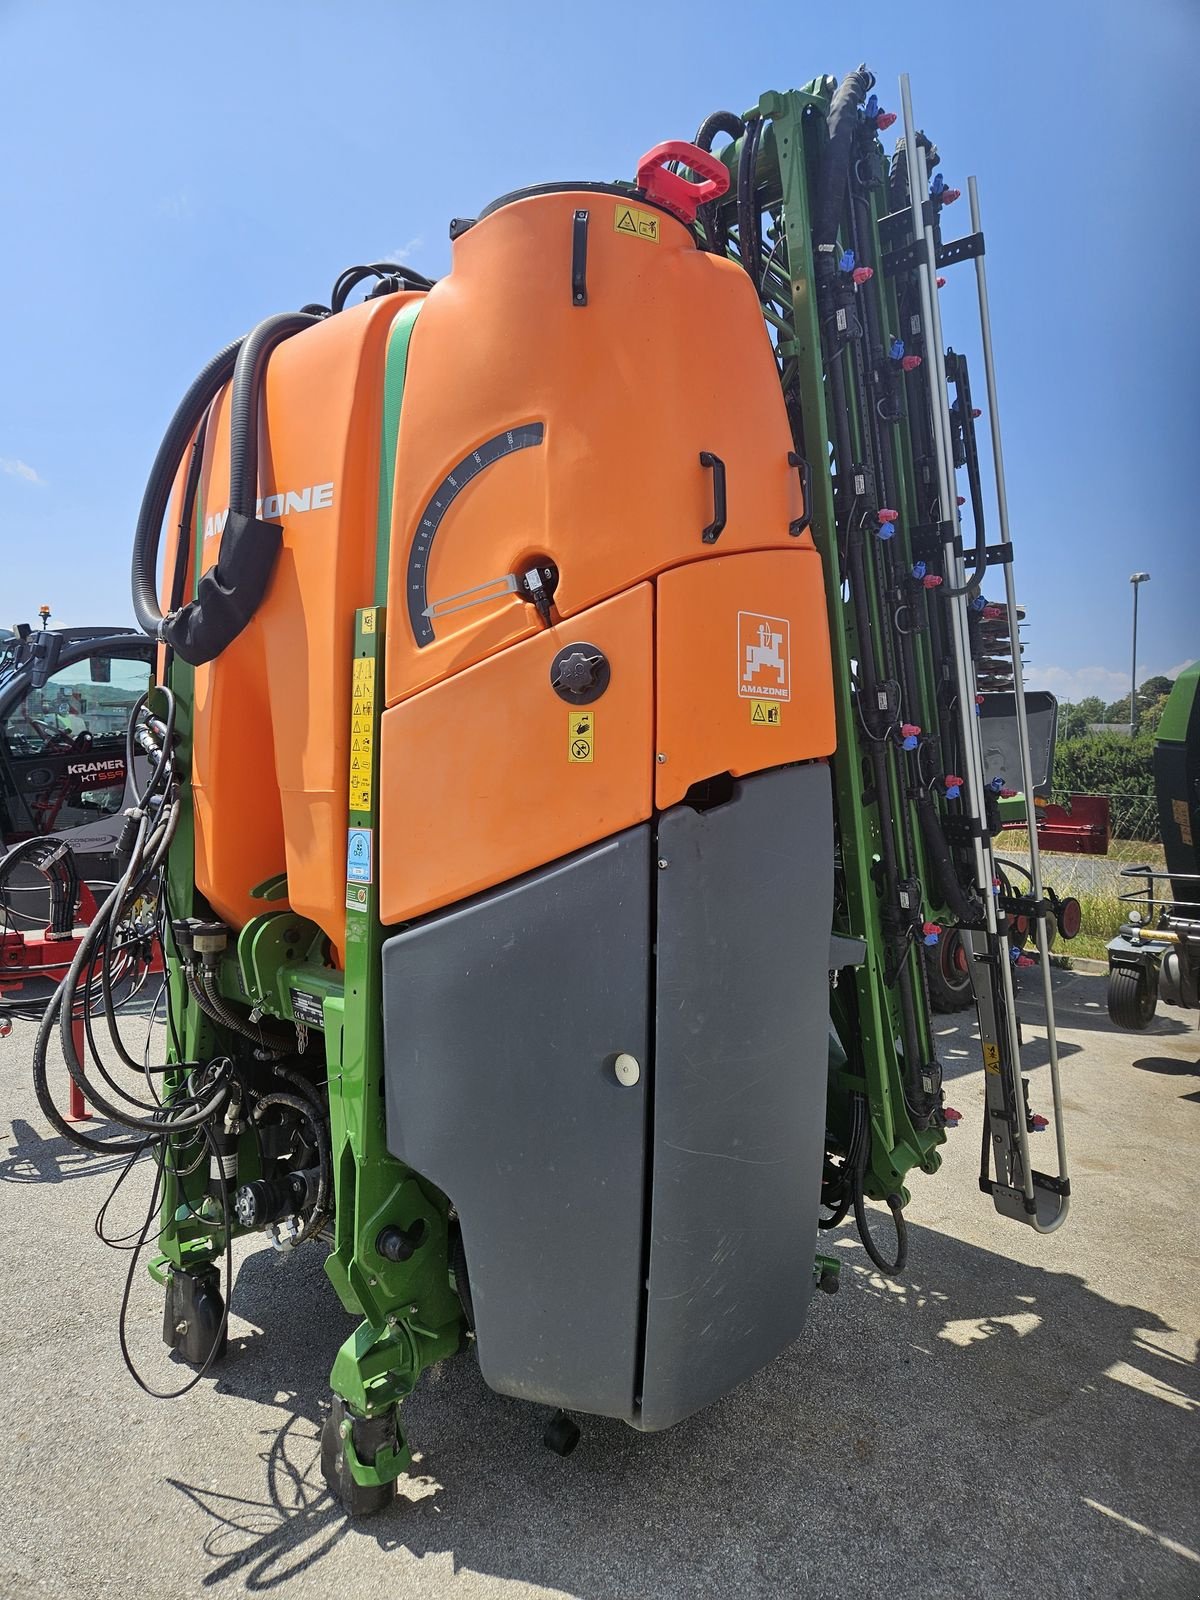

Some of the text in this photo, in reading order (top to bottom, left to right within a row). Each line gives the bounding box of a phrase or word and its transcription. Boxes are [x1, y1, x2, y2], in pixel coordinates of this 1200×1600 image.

[506, 431, 514, 445] 2000
[472, 451, 482, 464] 1500
[447, 475, 457, 487] 1000
[204, 482, 334, 540] AMONE
[423, 519, 432, 527] 500
[741, 685, 788, 696] AMAZONE
[68, 759, 125, 774] KRAMER
